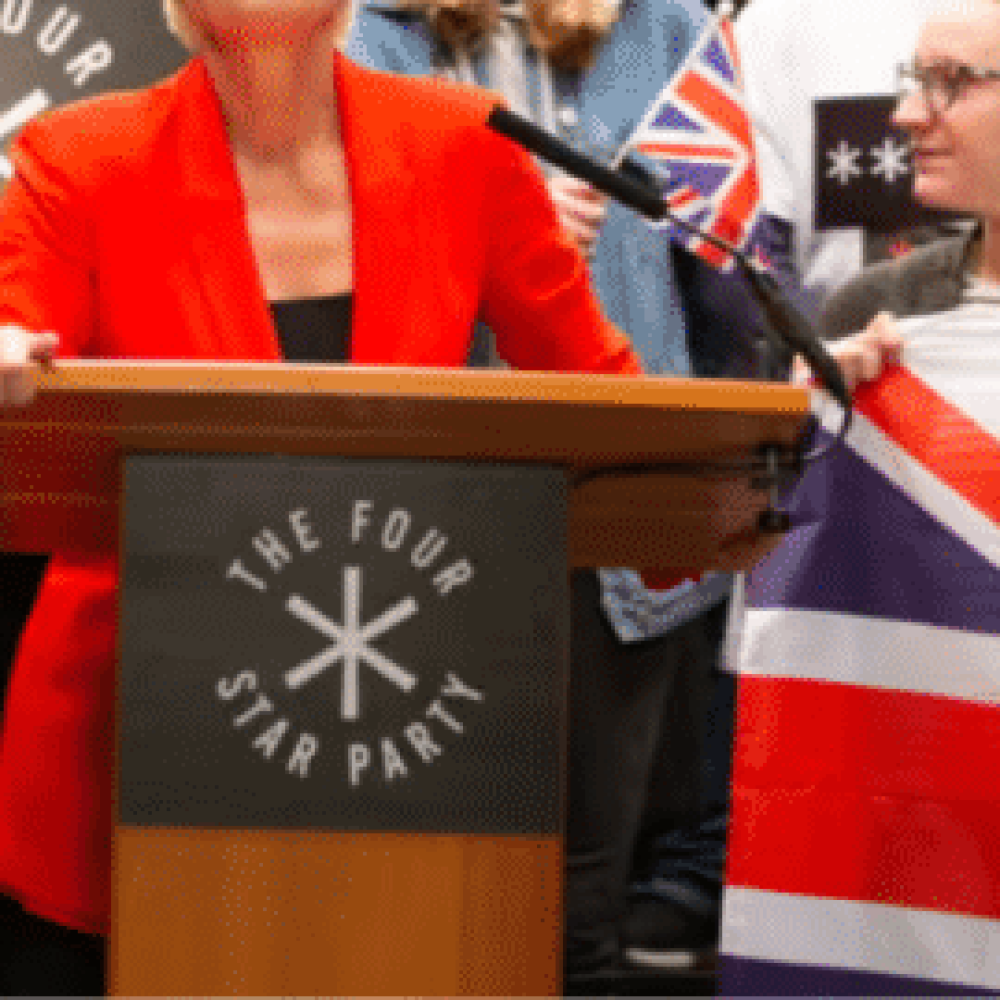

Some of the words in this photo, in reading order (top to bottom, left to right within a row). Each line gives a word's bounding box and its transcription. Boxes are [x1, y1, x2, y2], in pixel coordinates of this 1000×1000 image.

[226, 507, 320, 591] THE
[350, 500, 475, 595] FOUR
[216, 669, 319, 778] STAR
[348, 670, 486, 788] PARTY
